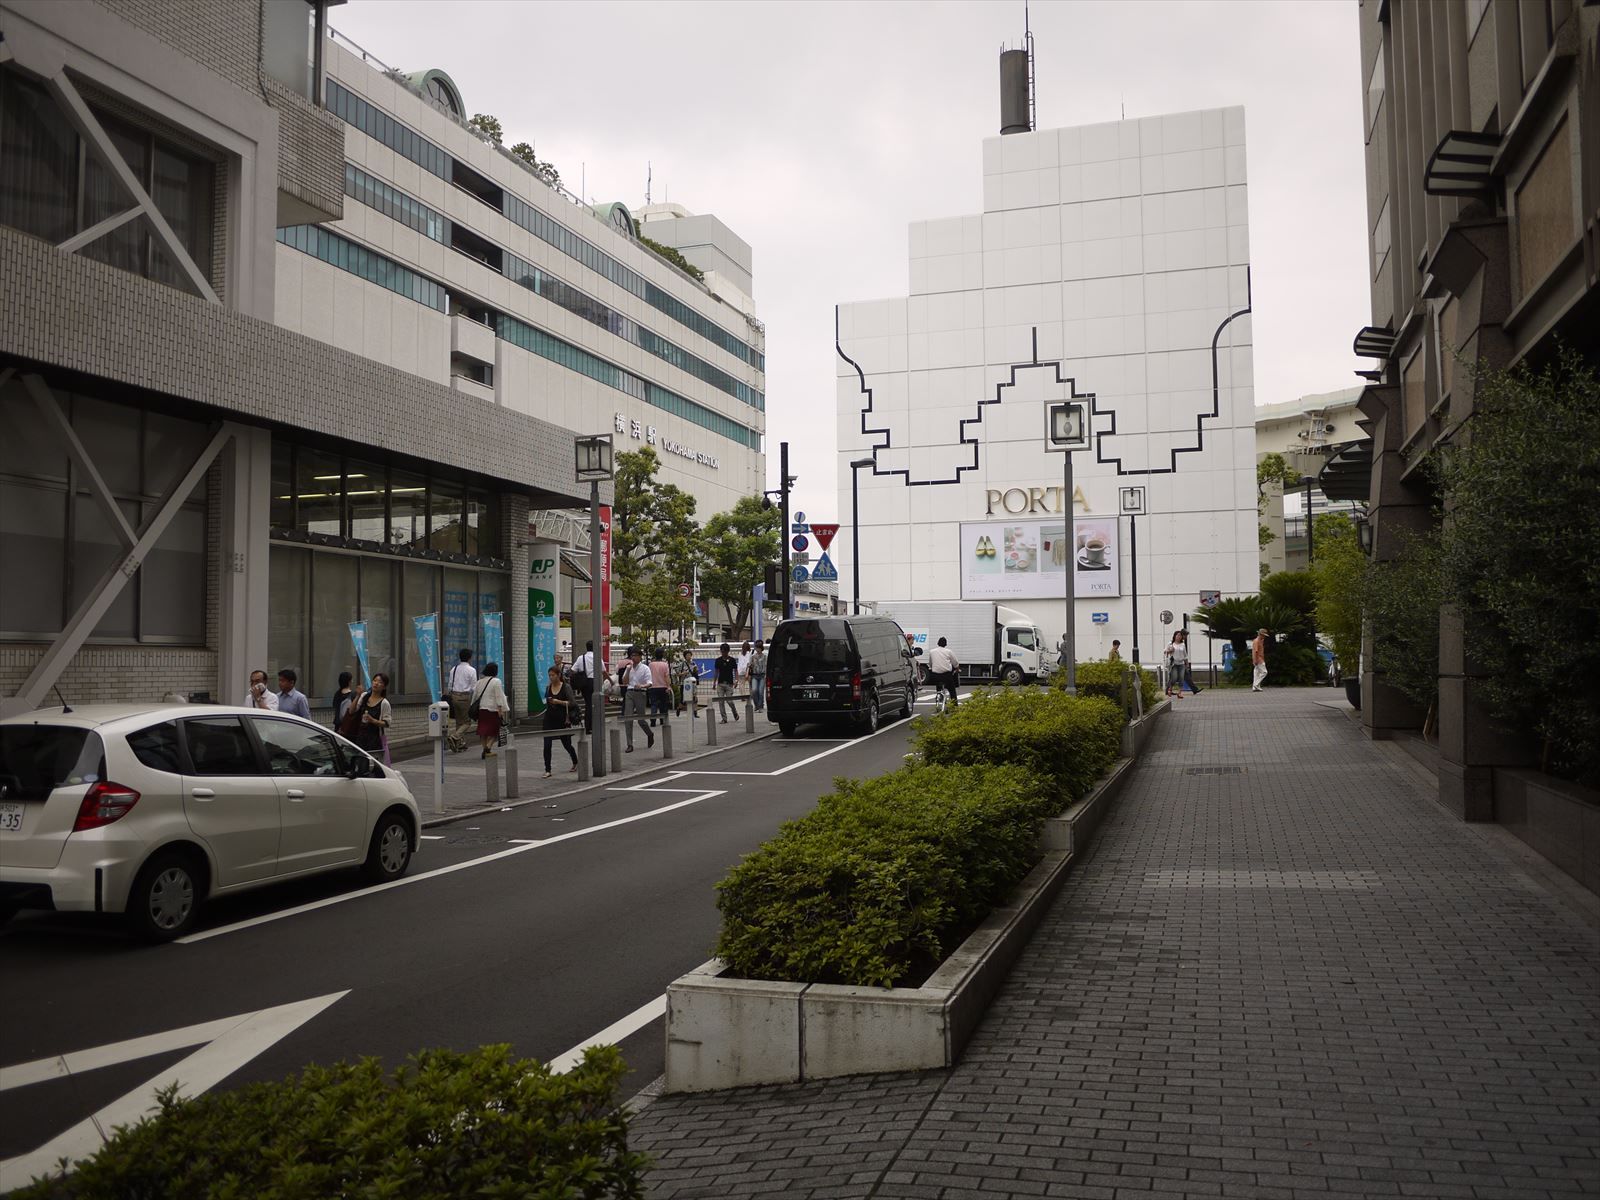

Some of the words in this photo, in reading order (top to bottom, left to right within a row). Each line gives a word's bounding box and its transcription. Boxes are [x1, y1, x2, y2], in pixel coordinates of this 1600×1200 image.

[614, 411, 656, 445] 横浜駅
[662, 437, 696, 460] YOKOHAMA
[697, 452, 720, 469] STATION
[985, 485, 1090, 514] PORTA
[530, 559, 555, 574] JP
